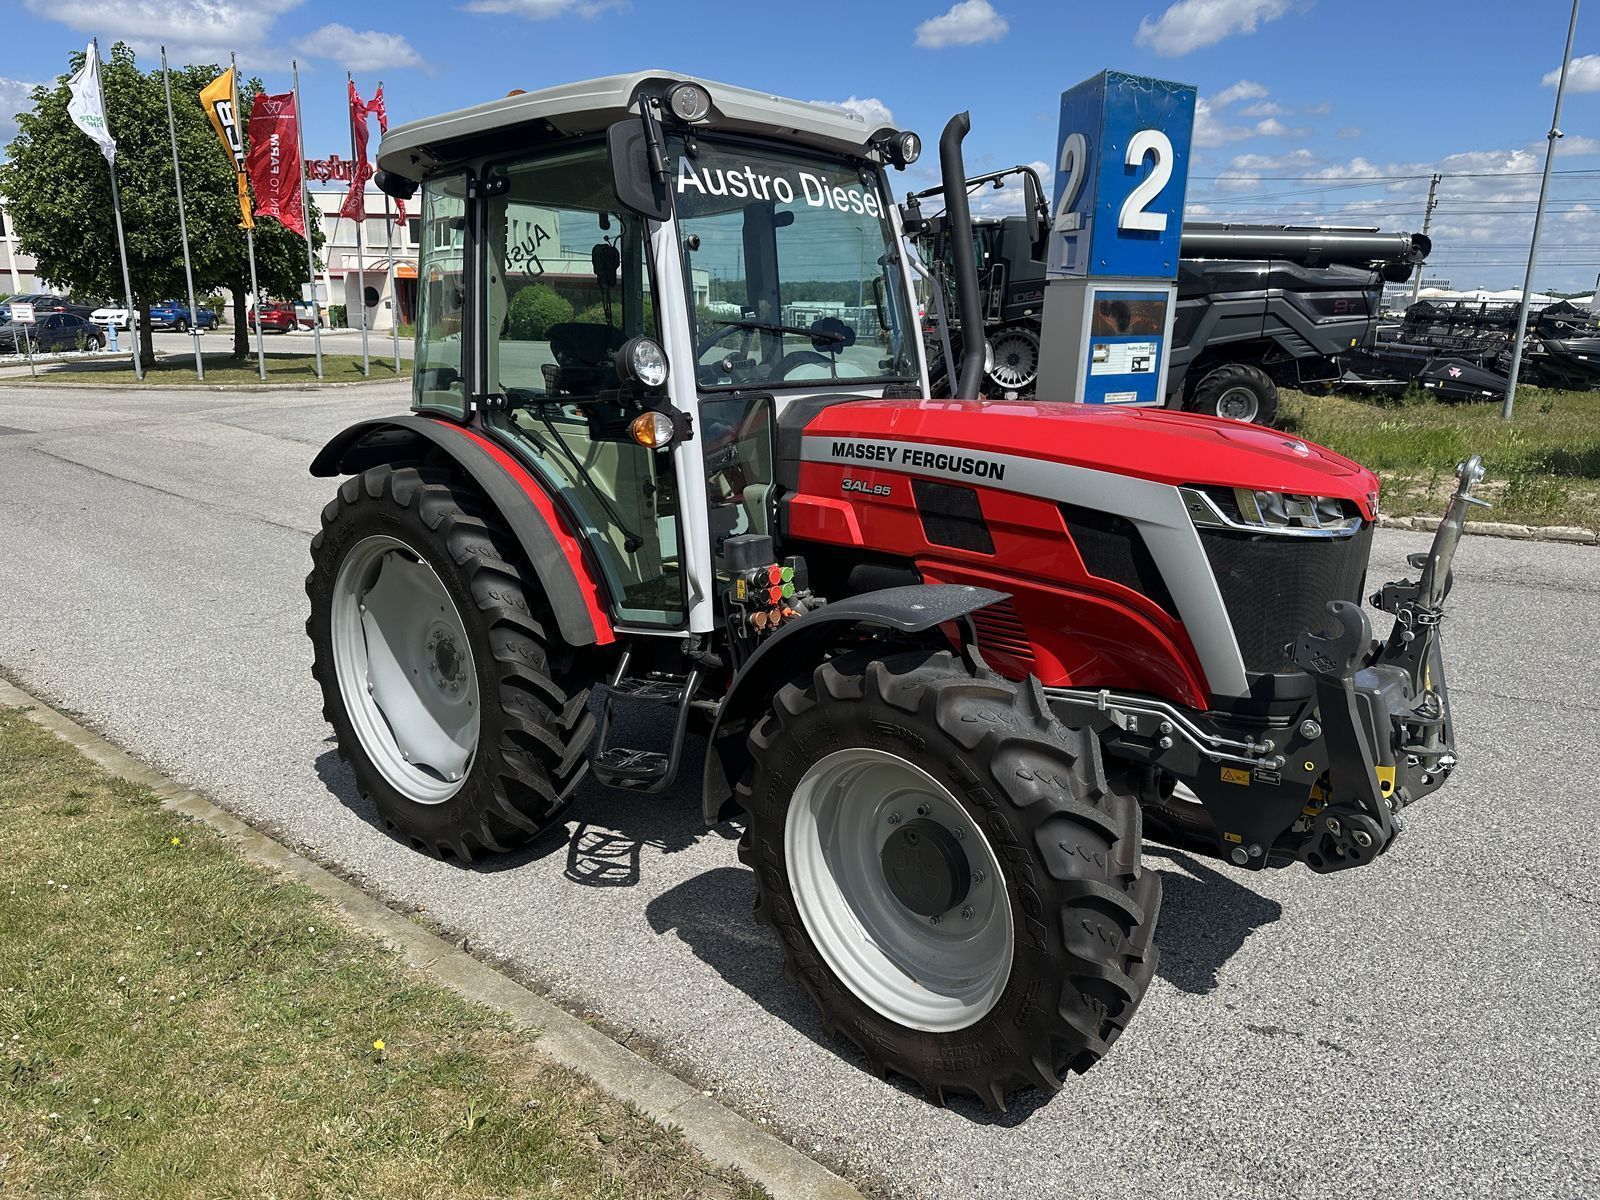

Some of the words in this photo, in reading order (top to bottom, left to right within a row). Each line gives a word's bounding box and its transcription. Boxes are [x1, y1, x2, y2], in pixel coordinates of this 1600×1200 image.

[676, 156, 794, 204] Austro
[798, 171, 885, 219] Diesel
[1055, 132, 1086, 231] 2
[1117, 129, 1174, 231] 2
[831, 442, 898, 463] MASSEY
[901, 448, 1006, 481] FERGUSON
[841, 478, 892, 496] 3AL.95
